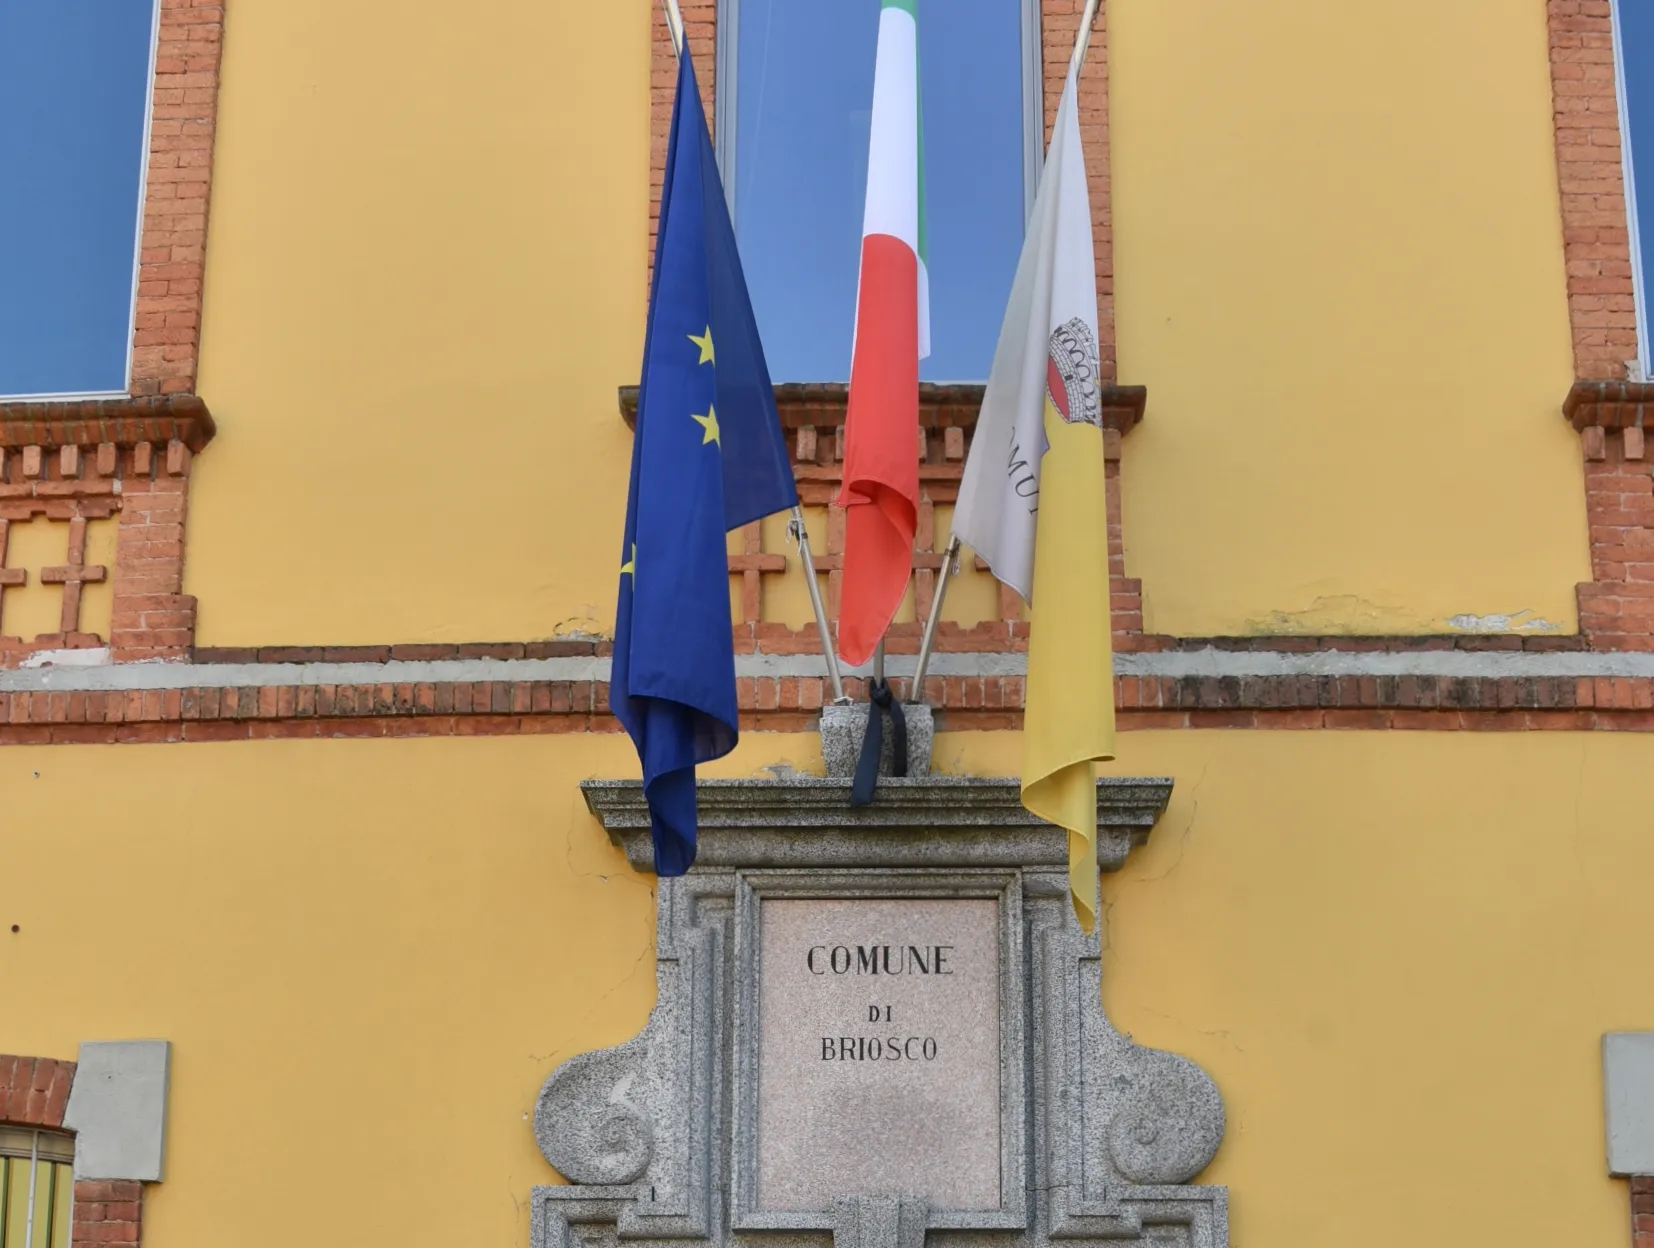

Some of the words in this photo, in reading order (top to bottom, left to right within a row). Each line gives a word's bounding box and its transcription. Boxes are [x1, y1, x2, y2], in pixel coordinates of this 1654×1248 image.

[807, 945, 954, 975] COMUNE
[868, 1005, 892, 1023] DI
[821, 1036, 937, 1061] BRIOSCO
